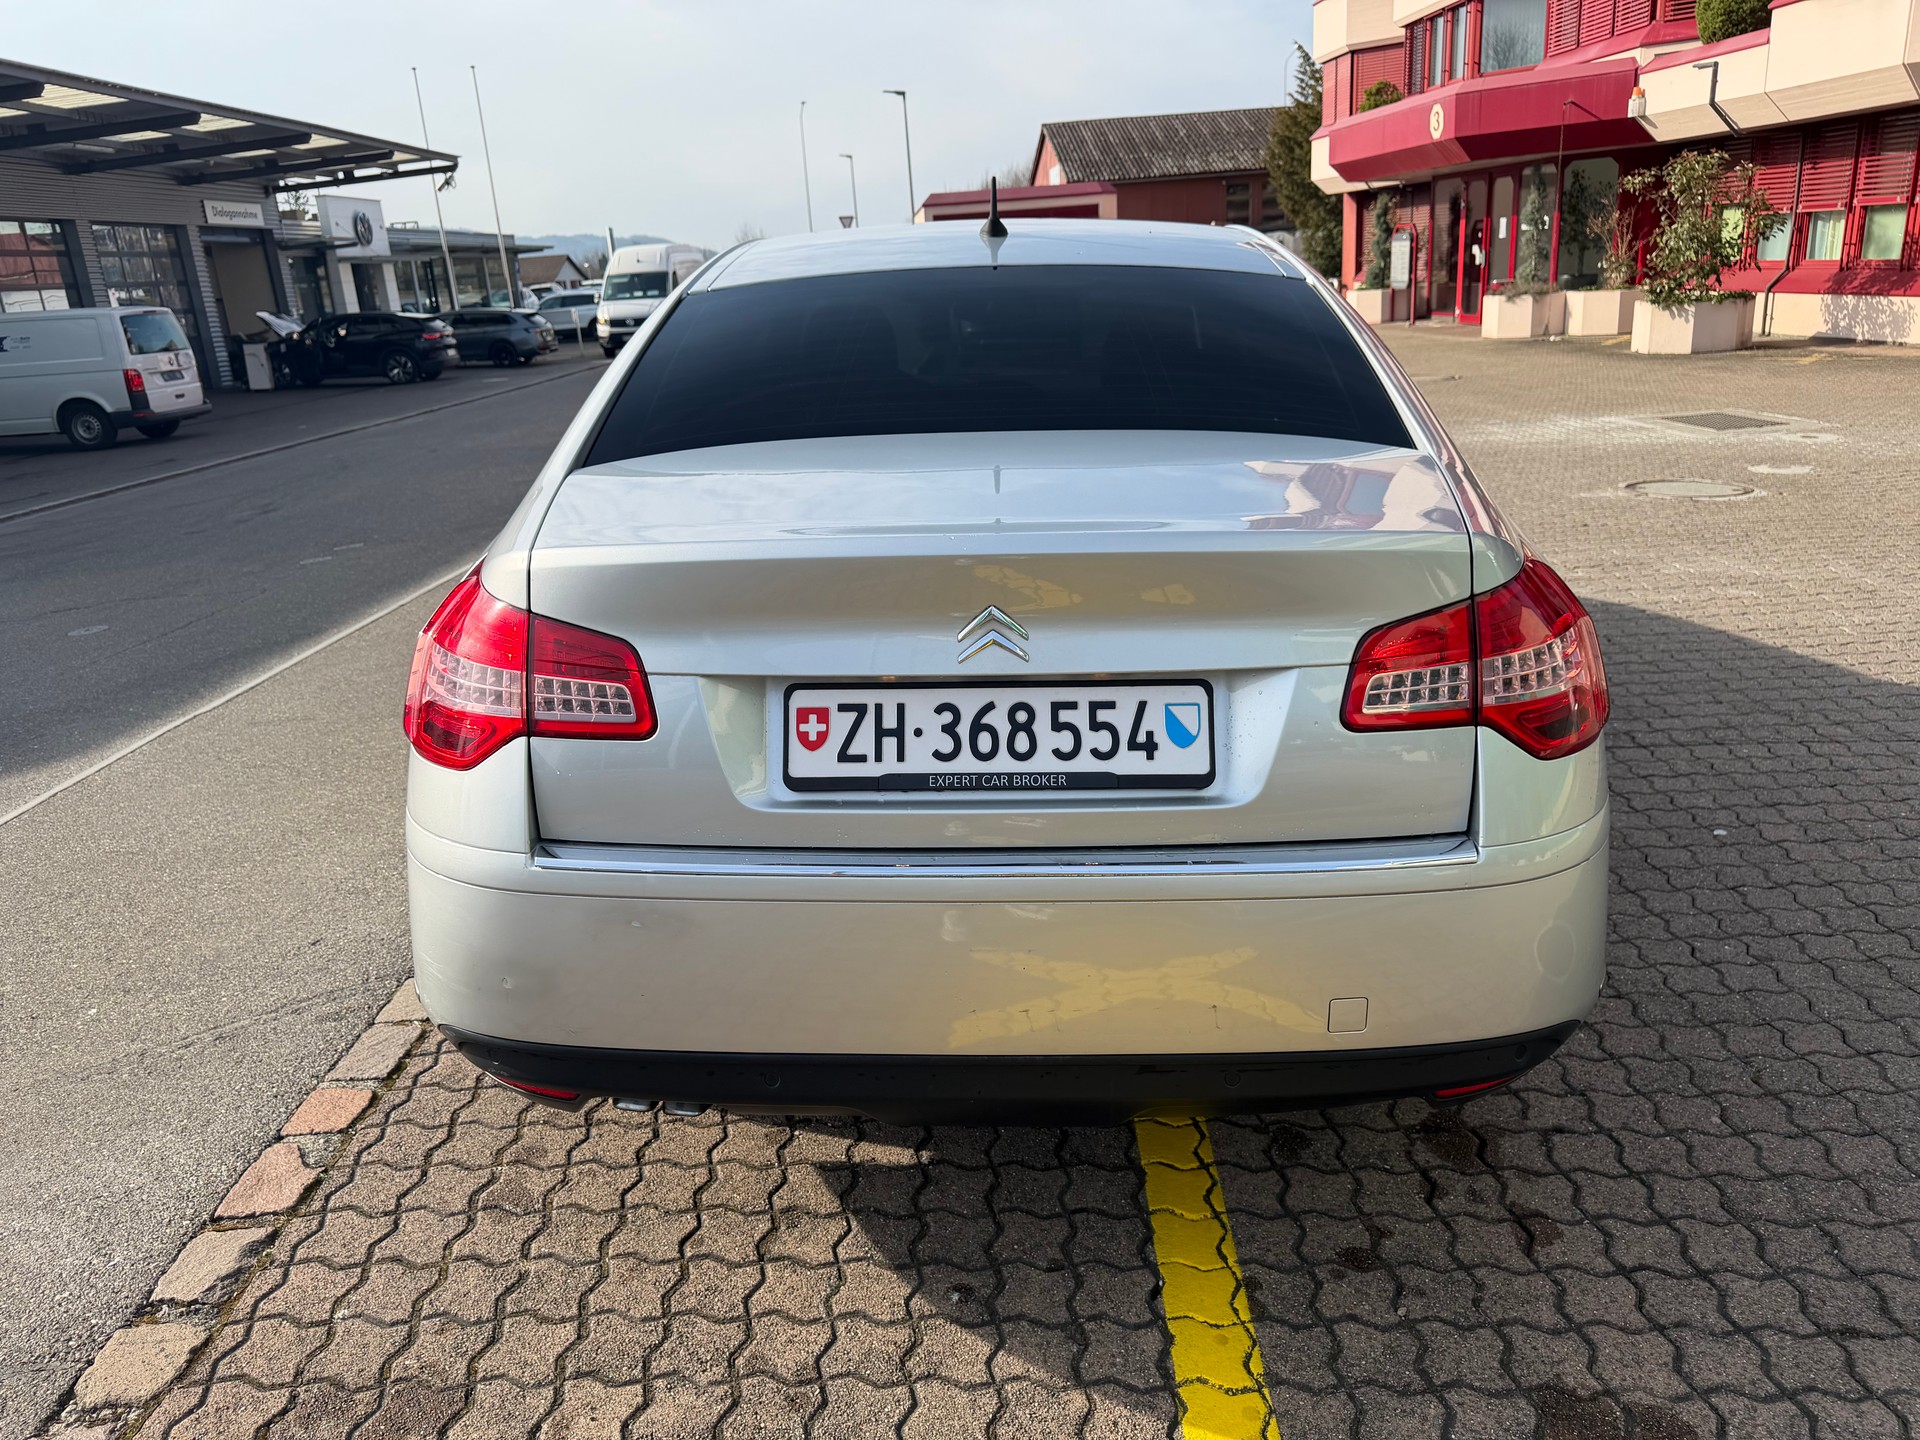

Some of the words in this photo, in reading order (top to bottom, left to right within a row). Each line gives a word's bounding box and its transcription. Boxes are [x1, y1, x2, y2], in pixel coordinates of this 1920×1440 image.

[1433, 111, 1440, 132] 3
[211, 205, 258, 221] Dialogannahme
[929, 775, 978, 788] EXPERT
[982, 775, 1010, 787] CAR
[1013, 774, 1067, 787] BROKER
